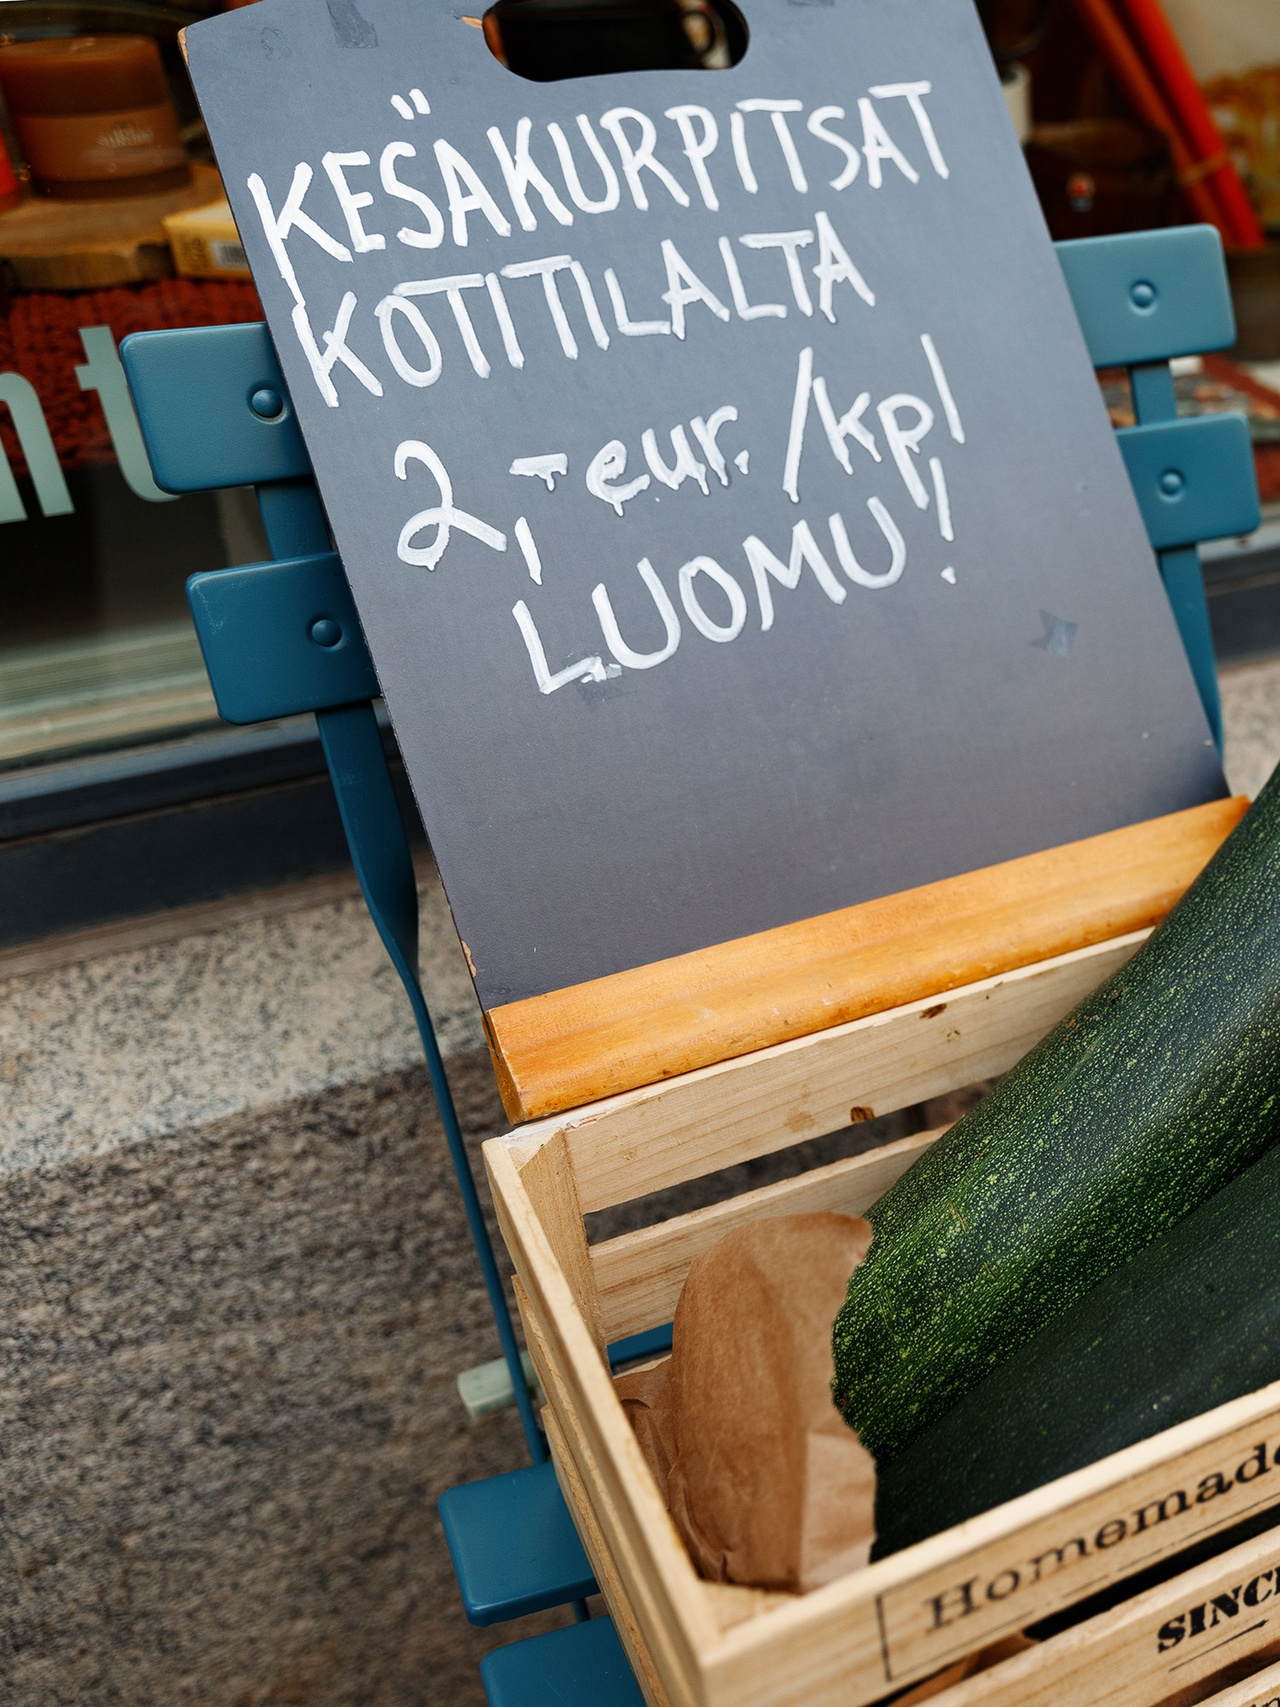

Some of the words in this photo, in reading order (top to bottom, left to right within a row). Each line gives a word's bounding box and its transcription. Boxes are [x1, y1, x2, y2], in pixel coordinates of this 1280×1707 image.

[291, 210, 877, 409] KOTITILALTA
[585, 404, 751, 518] eur.
[511, 455, 957, 695] LUOMU!
